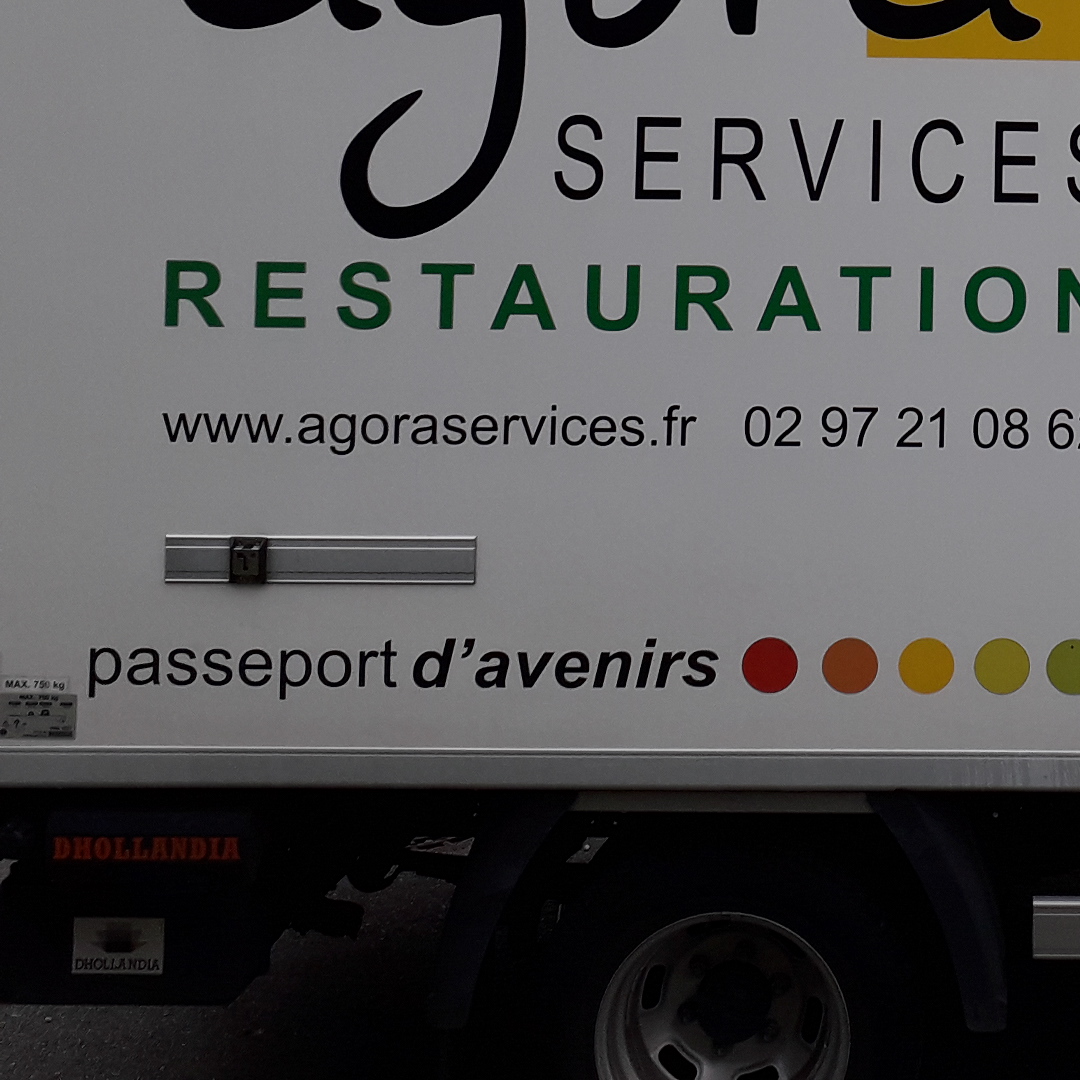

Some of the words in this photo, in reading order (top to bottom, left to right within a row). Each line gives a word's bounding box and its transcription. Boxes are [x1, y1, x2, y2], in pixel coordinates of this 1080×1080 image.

[162, 405, 697, 455] www.agoraservices.fr
[744, 406, 802, 448] 02
[821, 407, 879, 448] 97
[897, 407, 946, 449] 21
[973, 408, 1030, 449] 08
[88, 640, 397, 700] passeport
[53, 680, 65, 691] kg
[52, 835, 240, 860] DHOLLANDIA
[75, 958, 160, 970] DHOLLANDIA
